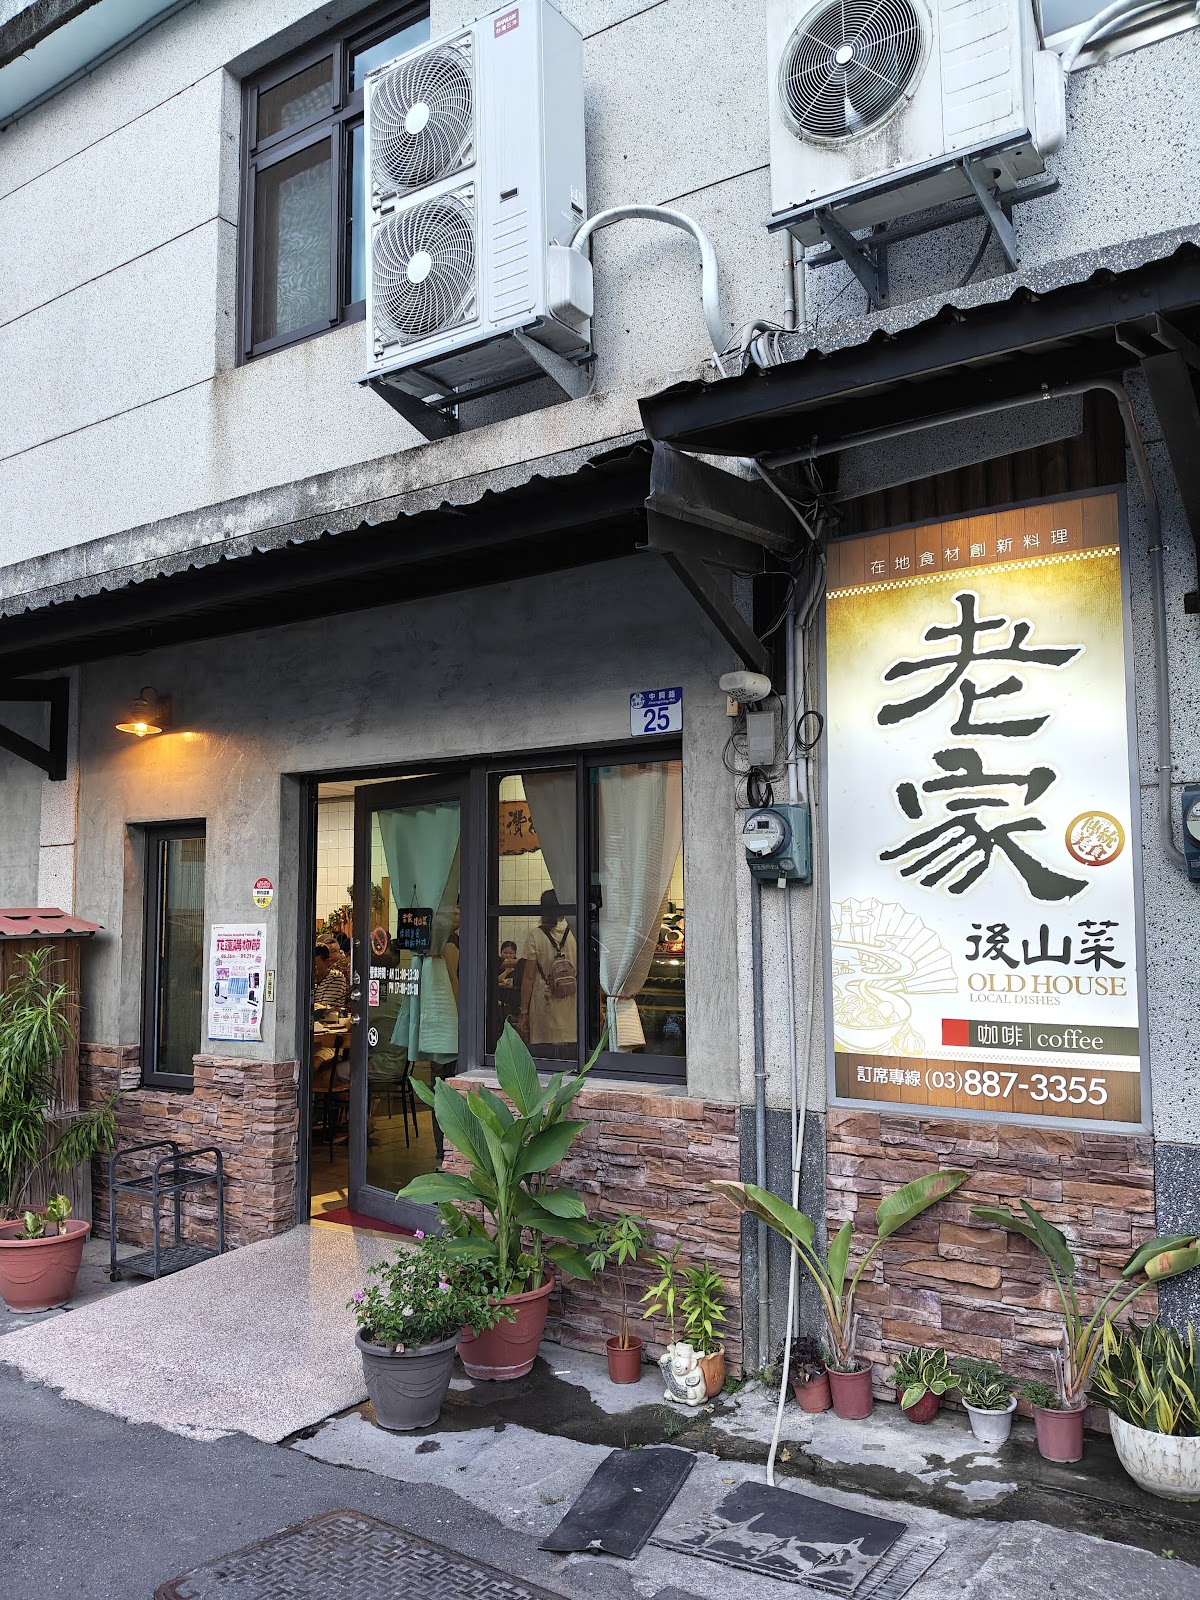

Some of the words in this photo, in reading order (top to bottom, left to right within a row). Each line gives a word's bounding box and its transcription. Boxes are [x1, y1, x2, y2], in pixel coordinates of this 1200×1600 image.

[870, 528, 1068, 575] 在地食材創新料理
[648, 690, 676, 701] 中興路
[643, 706, 670, 733] 25
[877, 593, 1089, 901] 老家
[217, 938, 260, 951] 花蓮購物節
[965, 919, 1126, 972] 後山菜
[967, 973, 1026, 993] OLD
[1031, 975, 1127, 997] HOUSE
[970, 993, 1011, 1004] LOCAL
[1014, 995, 1060, 1006] DISHES
[977, 1024, 1024, 1047] 咖啡
[1037, 1029, 1104, 1050] coffee
[857, 1065, 921, 1087] 訂席專線
